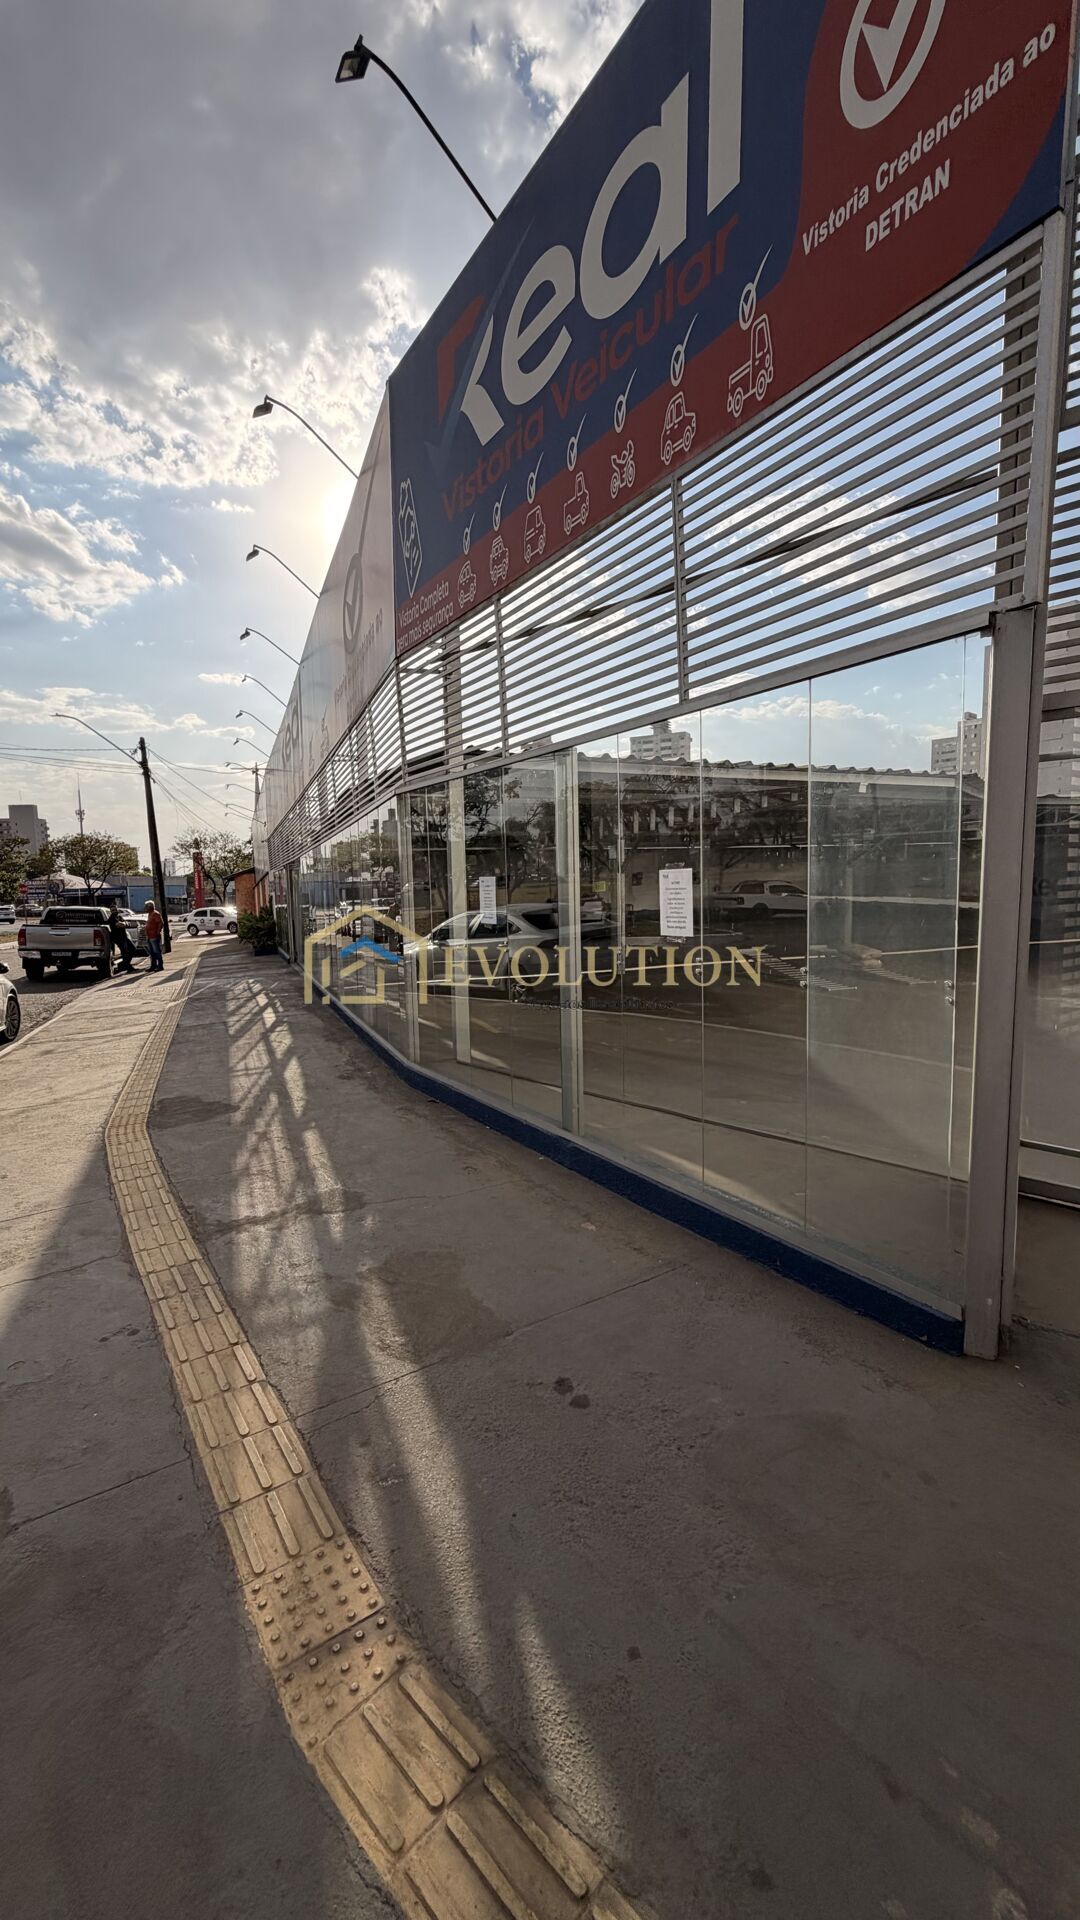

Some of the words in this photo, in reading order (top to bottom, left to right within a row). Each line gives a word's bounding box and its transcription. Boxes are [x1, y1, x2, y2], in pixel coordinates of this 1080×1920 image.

[802, 185, 869, 255] Vistoria
[875, 56, 1014, 194] Credenciada
[1023, 22, 1056, 68] ao
[865, 158, 950, 252] DETRAN
[442, 408, 545, 521] Vistoria
[550, 213, 739, 419] Veicular
[399, 601, 419, 628] Vistoria
[420, 580, 449, 614] Completa
[409, 621, 421, 642] mais
